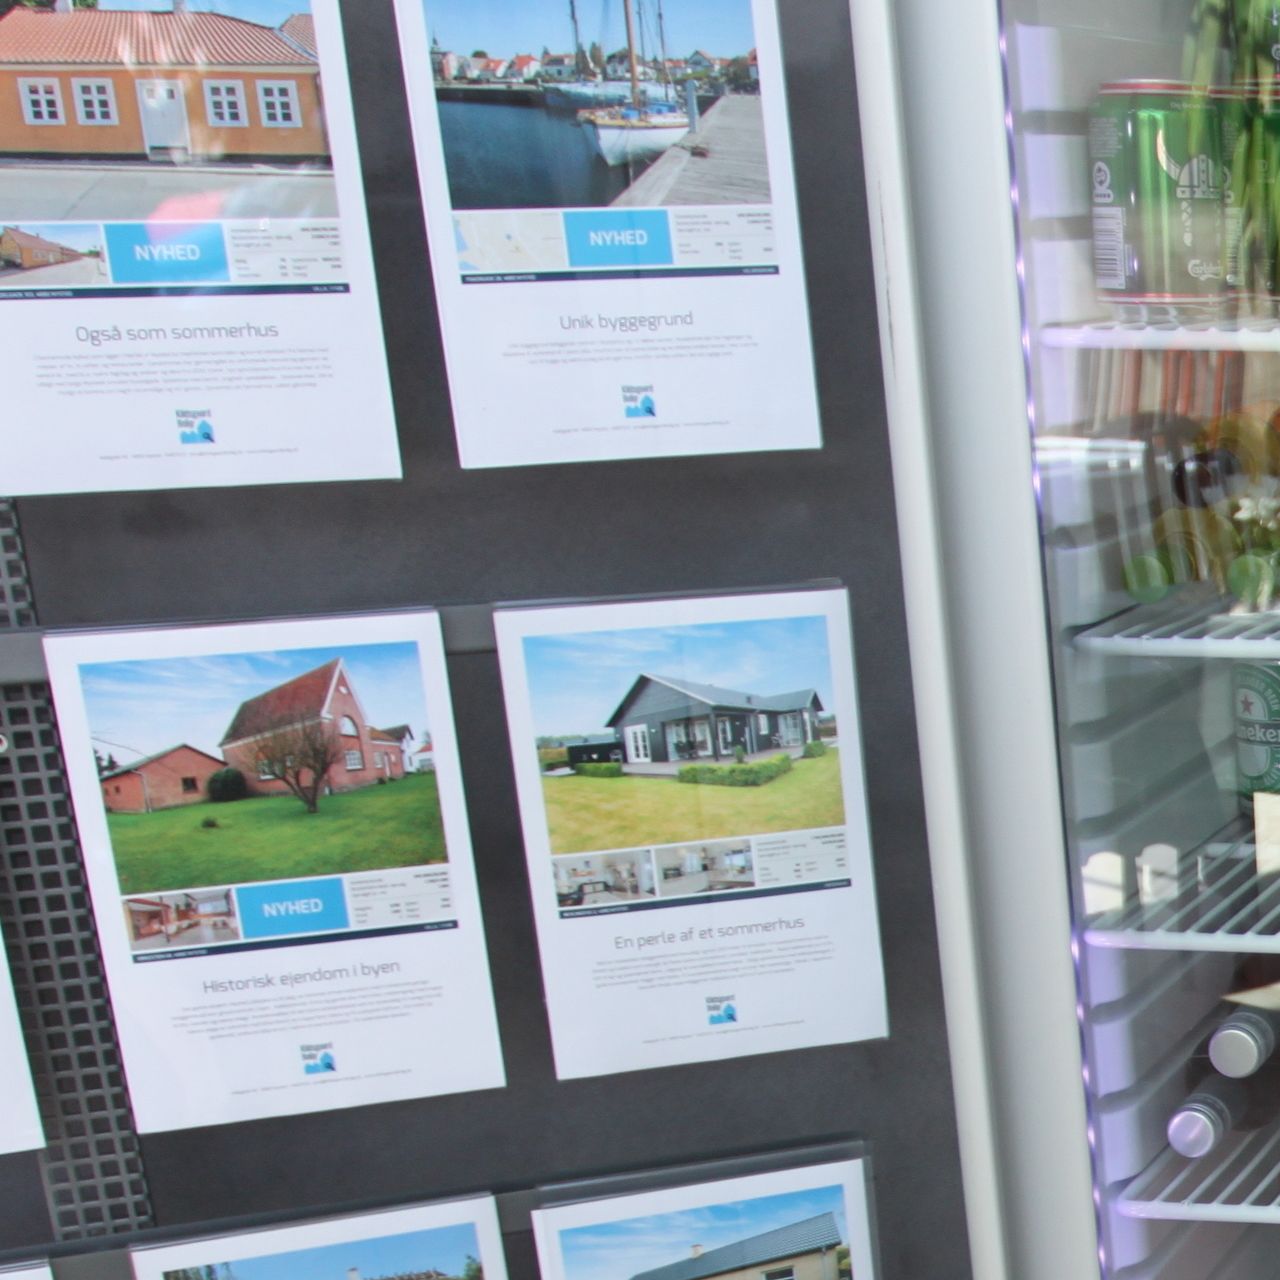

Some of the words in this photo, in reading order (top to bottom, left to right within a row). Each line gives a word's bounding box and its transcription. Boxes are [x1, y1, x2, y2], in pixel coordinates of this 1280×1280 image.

[590, 230, 648, 246] NYHED
[134, 244, 200, 262] NYHED
[559, 313, 594, 330] Unik
[598, 310, 694, 333] byggegrund
[75, 322, 123, 347] Også
[127, 326, 167, 342] som
[171, 322, 280, 341] sommerhus
[262, 897, 323, 919] NYHED
[614, 936, 635, 950] En
[638, 929, 676, 950] perle
[680, 924, 695, 942] af
[699, 926, 714, 940] et
[717, 916, 805, 938] sommerhus
[203, 974, 275, 995] Historisk
[280, 965, 350, 989] ejendom
[361, 960, 401, 982] byen
